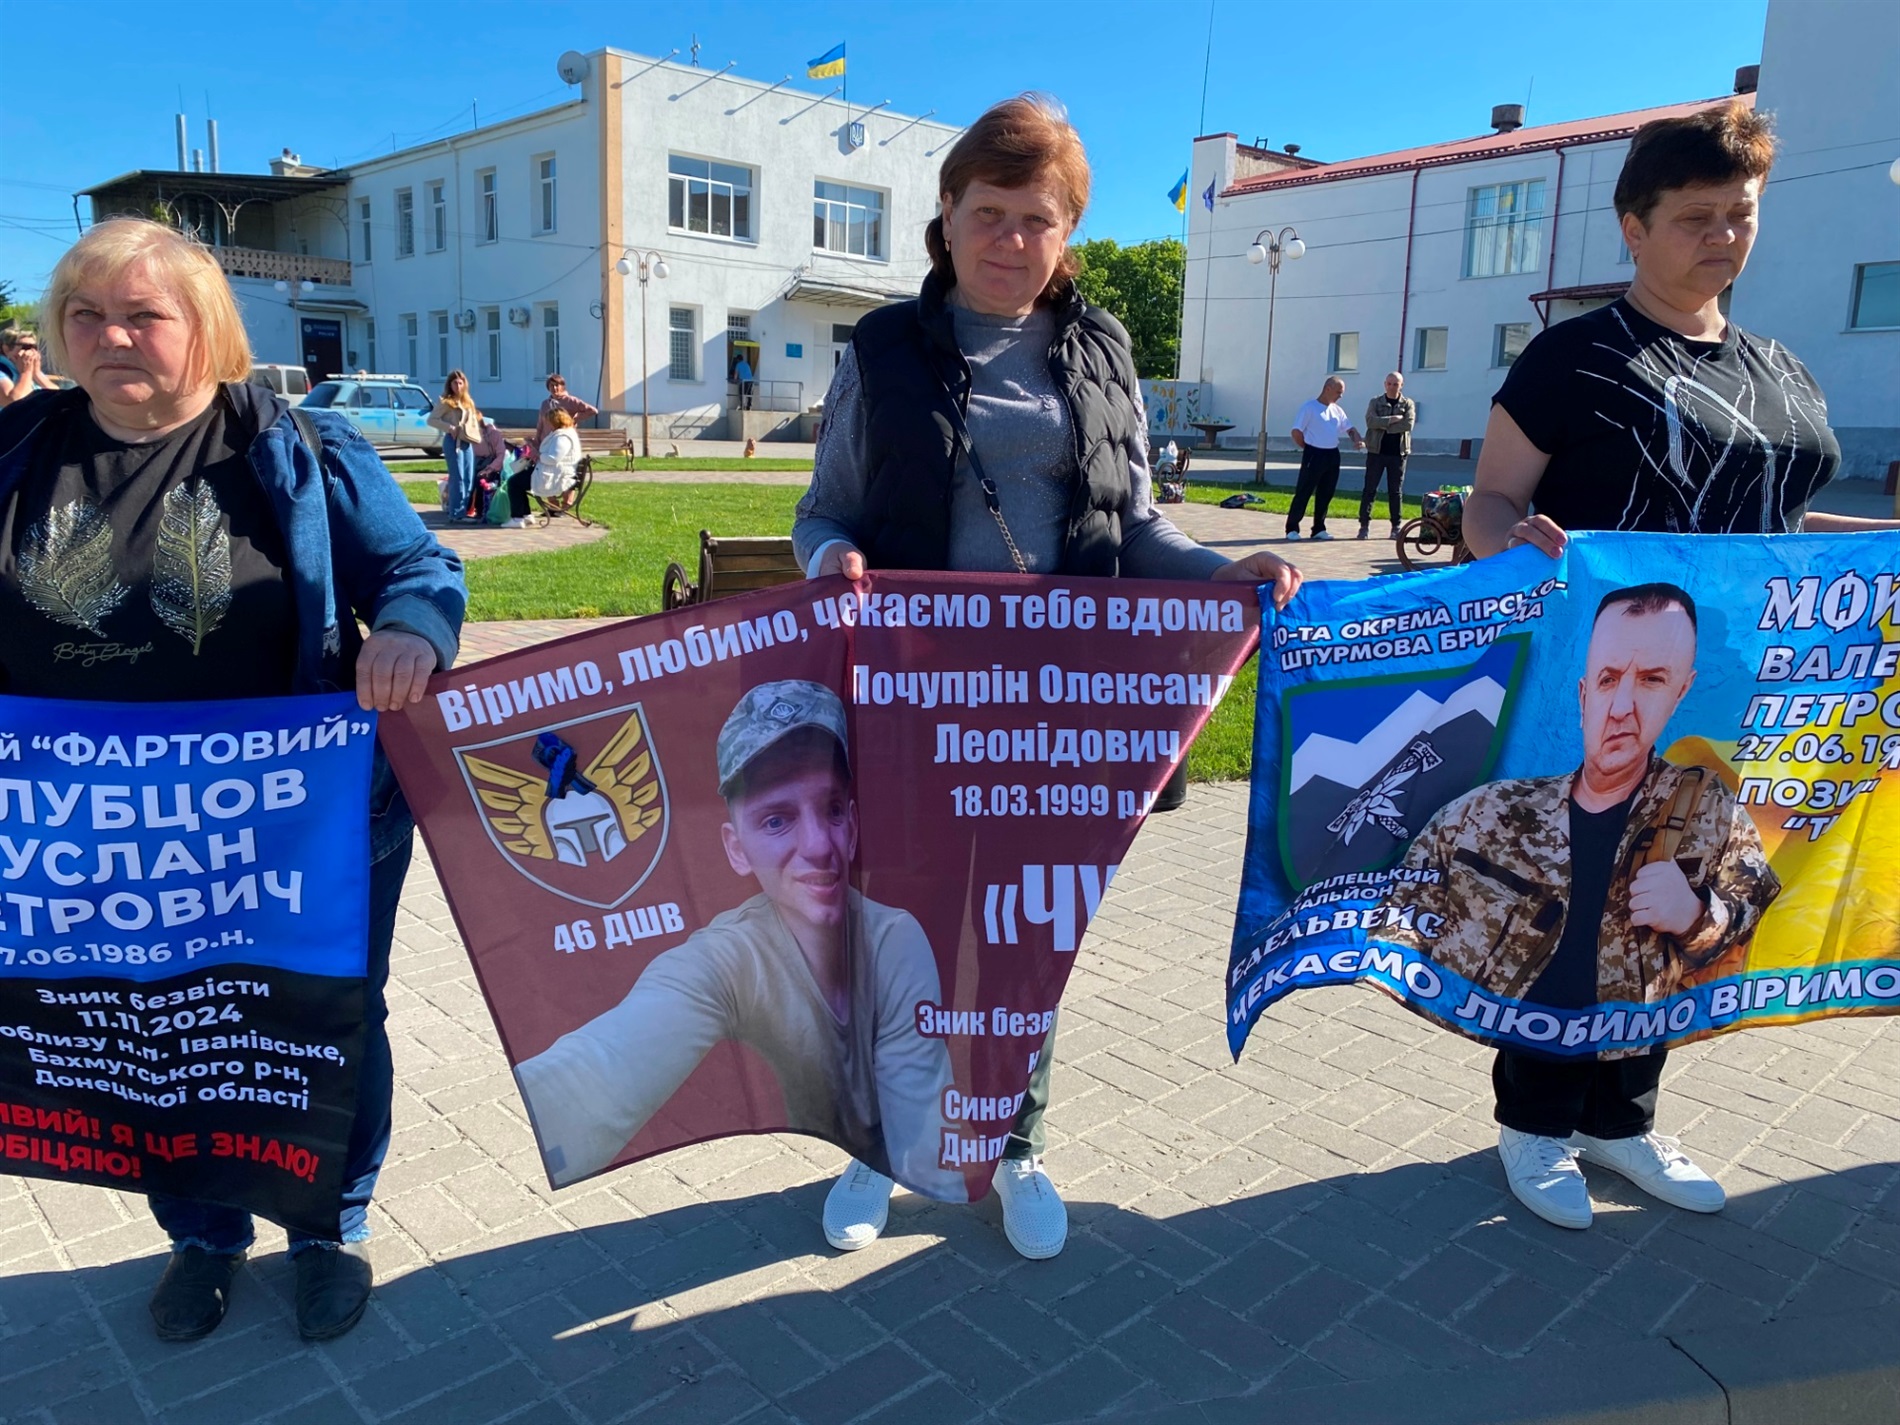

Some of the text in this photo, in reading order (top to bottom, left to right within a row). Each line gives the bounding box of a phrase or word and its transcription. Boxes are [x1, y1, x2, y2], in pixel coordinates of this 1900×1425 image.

[1273, 626, 1332, 648] 10-ТА
[1341, 607, 1451, 640] ОКРЕМА
[1281, 602, 1542, 671] ШТУРМОВА БРИГДА
[436, 588, 1243, 733] Віримо, любимо, чекаємо тебе вдома
[1758, 643, 1900, 681] ВАЛЕ
[853, 664, 1029, 708] Почупрін
[31, 714, 371, 767] “ФАРТОВИЙ”
[934, 722, 1180, 767] Леонідович
[0, 768, 307, 832] ЛУБЦОВ
[950, 784, 1109, 817] 18.03.1999
[0, 827, 257, 886] УСЛАН
[0, 870, 303, 936] ТРОВИЧ
[186, 929, 254, 959] р.н.
[553, 902, 685, 954] 46 ДШВ
[1231, 904, 1446, 988] ЕДЕЛЬВЕЙС
[36, 977, 270, 1011] Зник безвісти
[1232, 948, 1900, 1047] ЧЕКАЄМО ЛЮБИМО ВІРИМО
[77, 1003, 243, 1037] 11.11.2024
[919, 1004, 986, 1036] Зник
[0, 1025, 345, 1067] облизу н.п. Іванівське,
[28, 1048, 309, 1086] Бахмутського р-н,
[35, 1069, 309, 1111] Донецької області
[0, 1134, 141, 1179] БІЦЯЮ!
[111, 1124, 134, 1147] Я
[145, 1132, 198, 1163] ЦЕ
[211, 1131, 319, 1183] ЗНАЮ!
